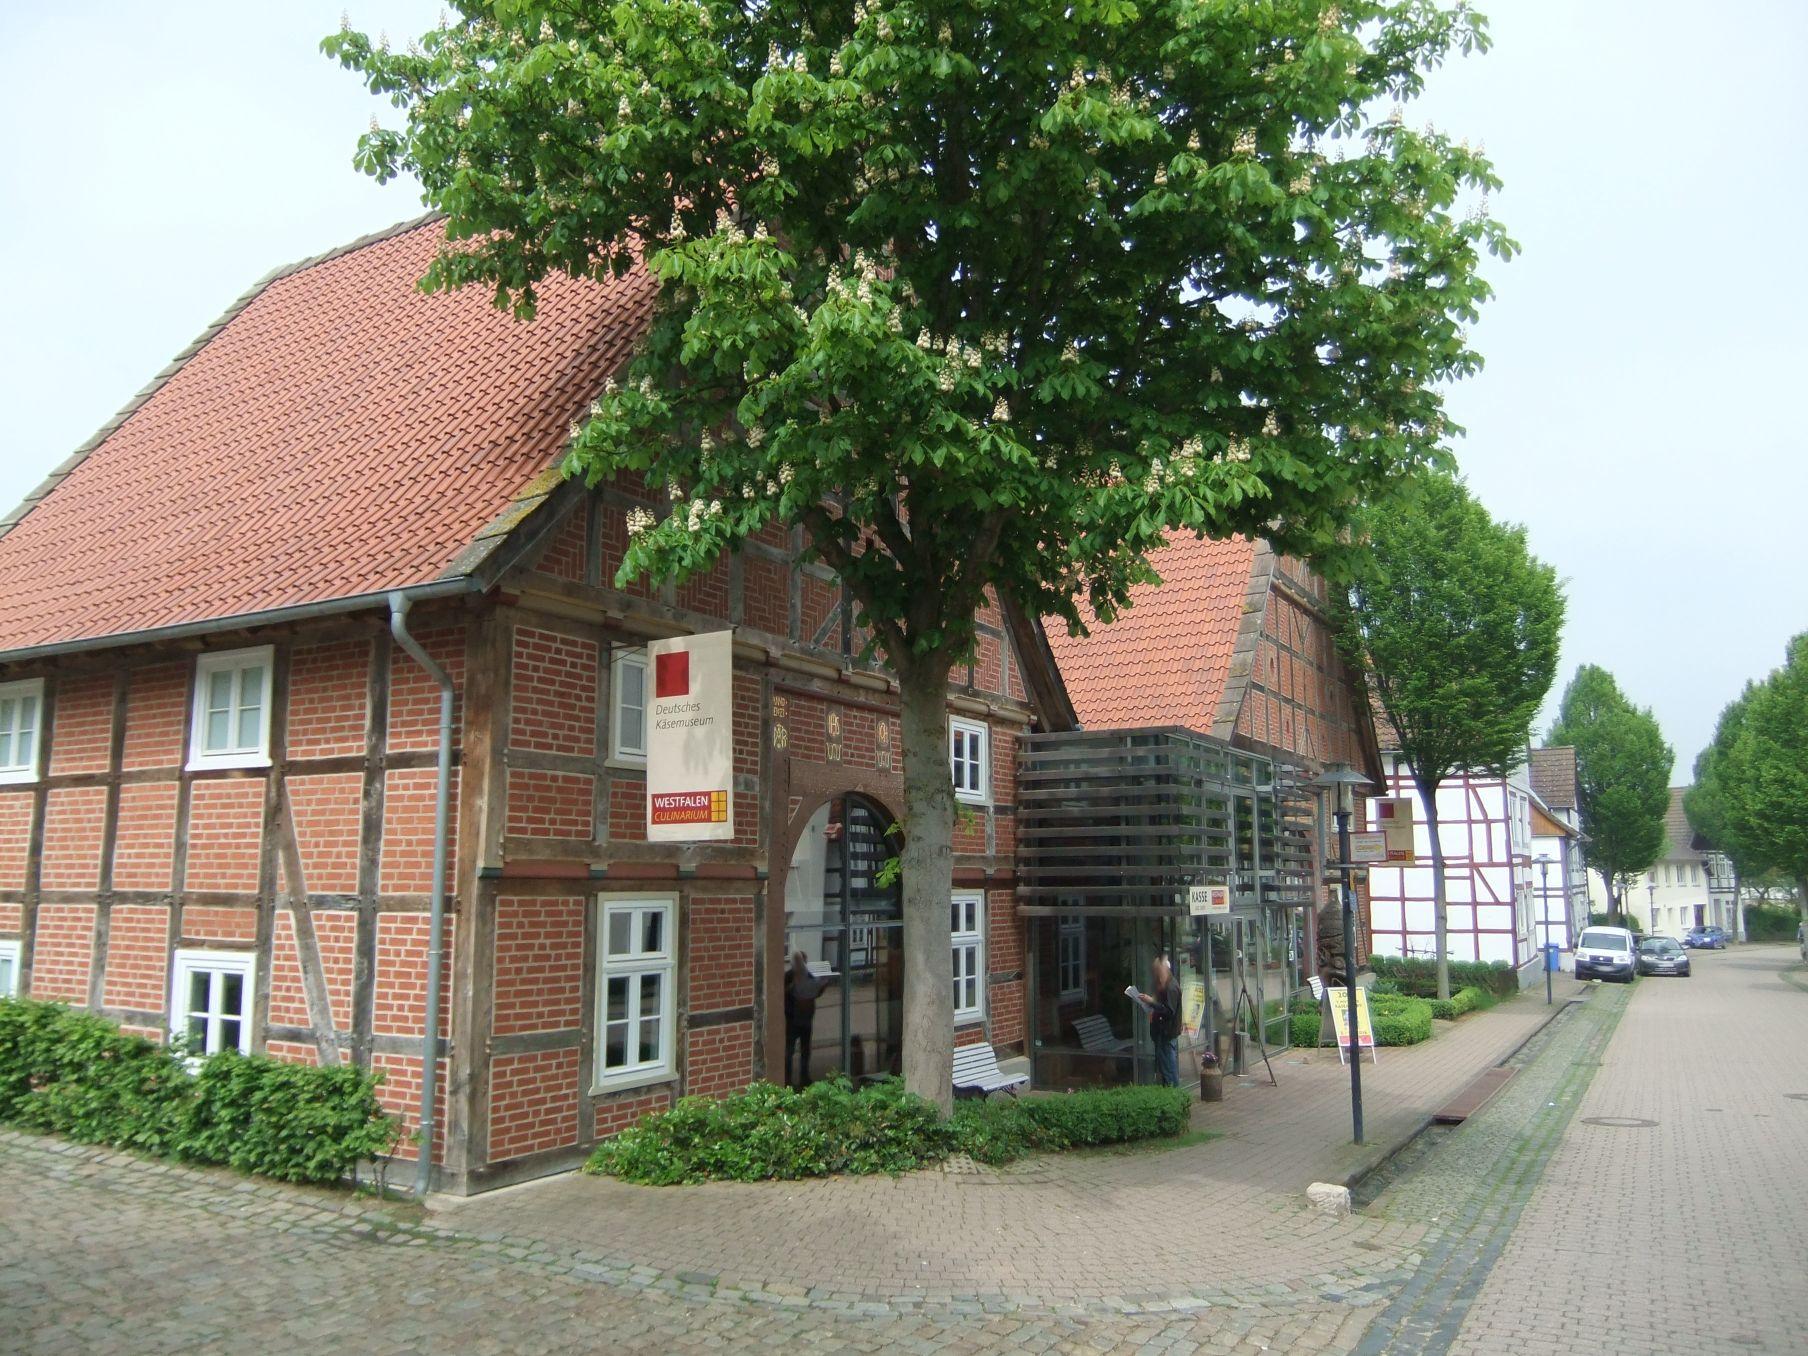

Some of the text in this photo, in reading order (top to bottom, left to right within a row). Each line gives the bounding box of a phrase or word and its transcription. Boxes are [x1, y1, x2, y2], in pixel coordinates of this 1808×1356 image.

[655, 701, 701, 715] Deutsches
[655, 716, 714, 730] Käsemuseum
[654, 795, 708, 808] WESTFALEN
[654, 809, 708, 821] CULINARIUM
[1191, 890, 1208, 903] KASSE
